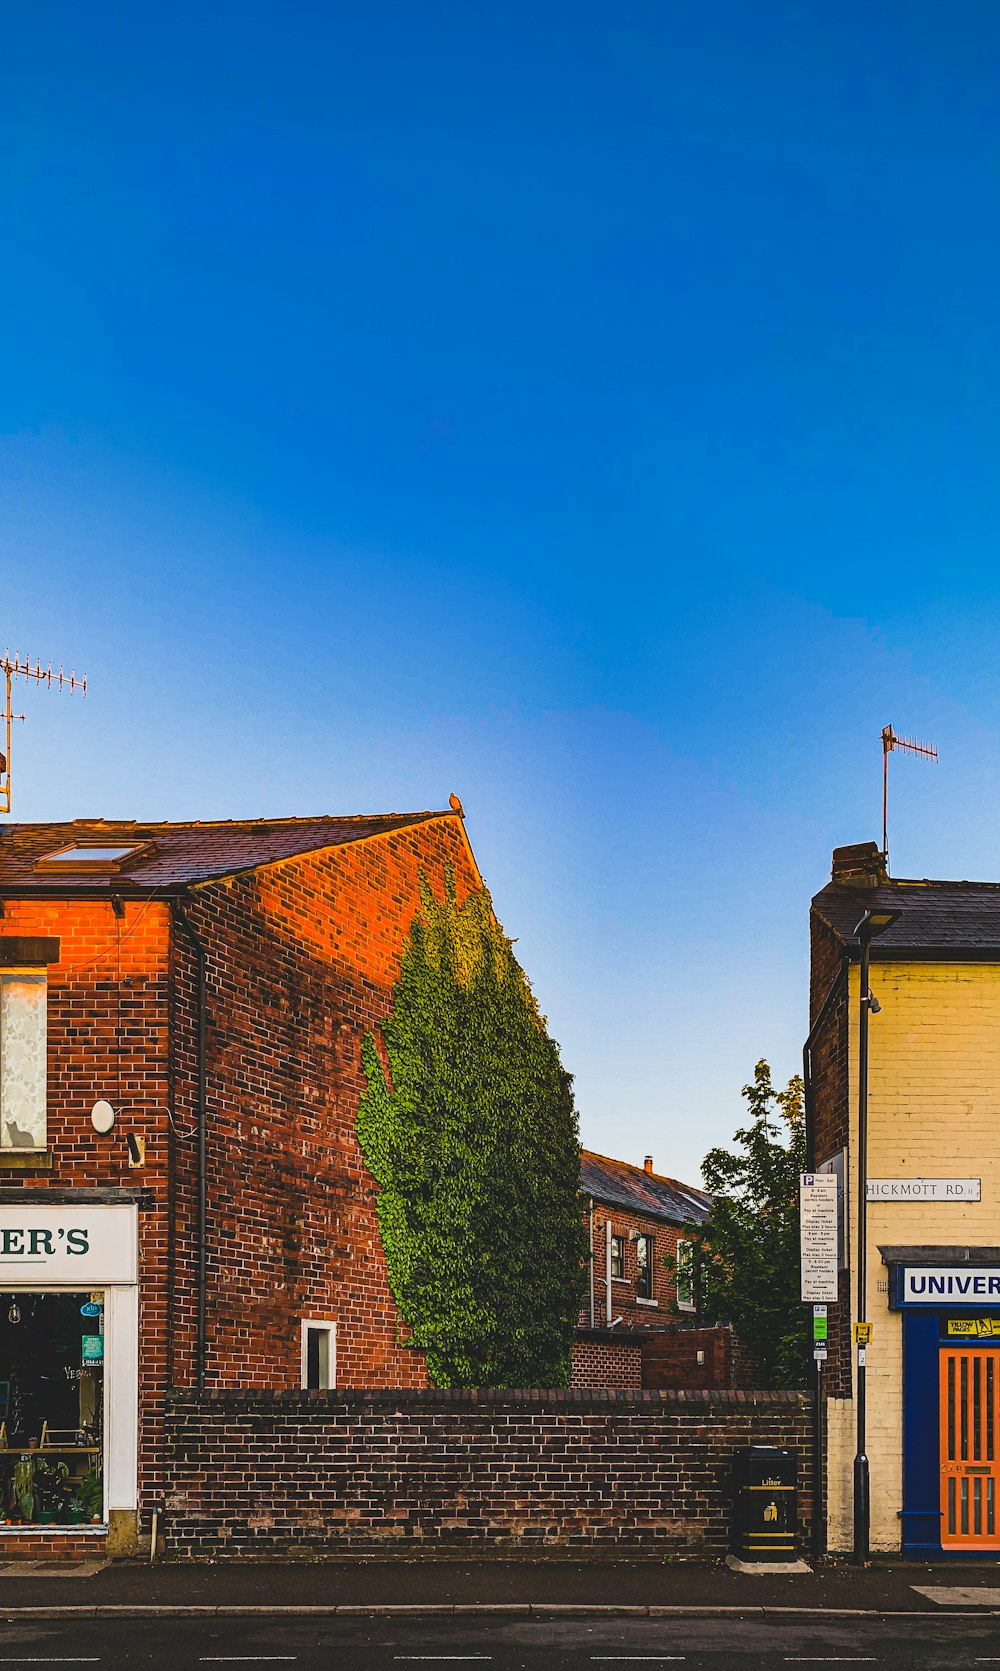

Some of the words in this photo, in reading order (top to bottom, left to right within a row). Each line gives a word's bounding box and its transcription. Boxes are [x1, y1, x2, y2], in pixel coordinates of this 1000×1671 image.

[866, 1184, 937, 1195] HICKMOTT
[946, 1184, 966, 1195] RD.
[0, 1228, 90, 1255] ER'S
[910, 1276, 1000, 1294] UNIVER
